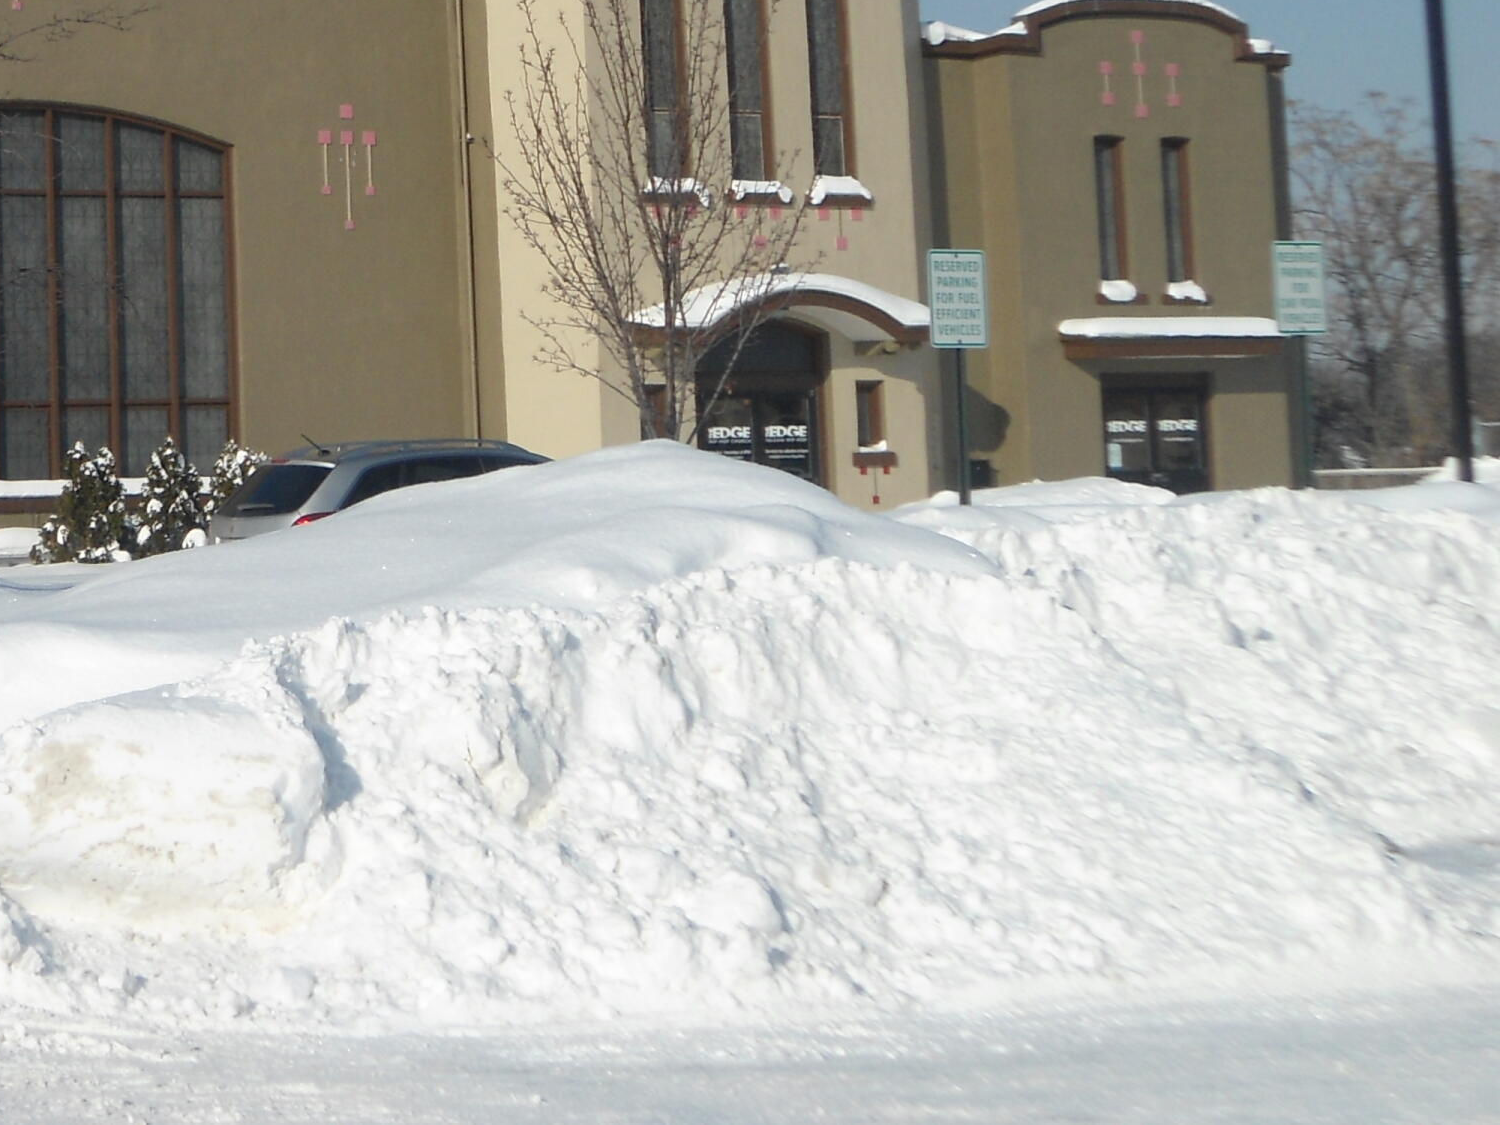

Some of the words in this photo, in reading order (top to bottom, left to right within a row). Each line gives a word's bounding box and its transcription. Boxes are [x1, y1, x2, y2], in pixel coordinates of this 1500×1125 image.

[934, 260, 979, 272] RESERVED
[937, 276, 978, 288] PARKING
[936, 292, 954, 304] FOR
[958, 292, 980, 304] FUEL
[936, 308, 980, 320] EFFICIENT
[938, 324, 981, 336] VEHICLES
[713, 427, 751, 439] EDGE
[770, 425, 807, 437] EDGE
